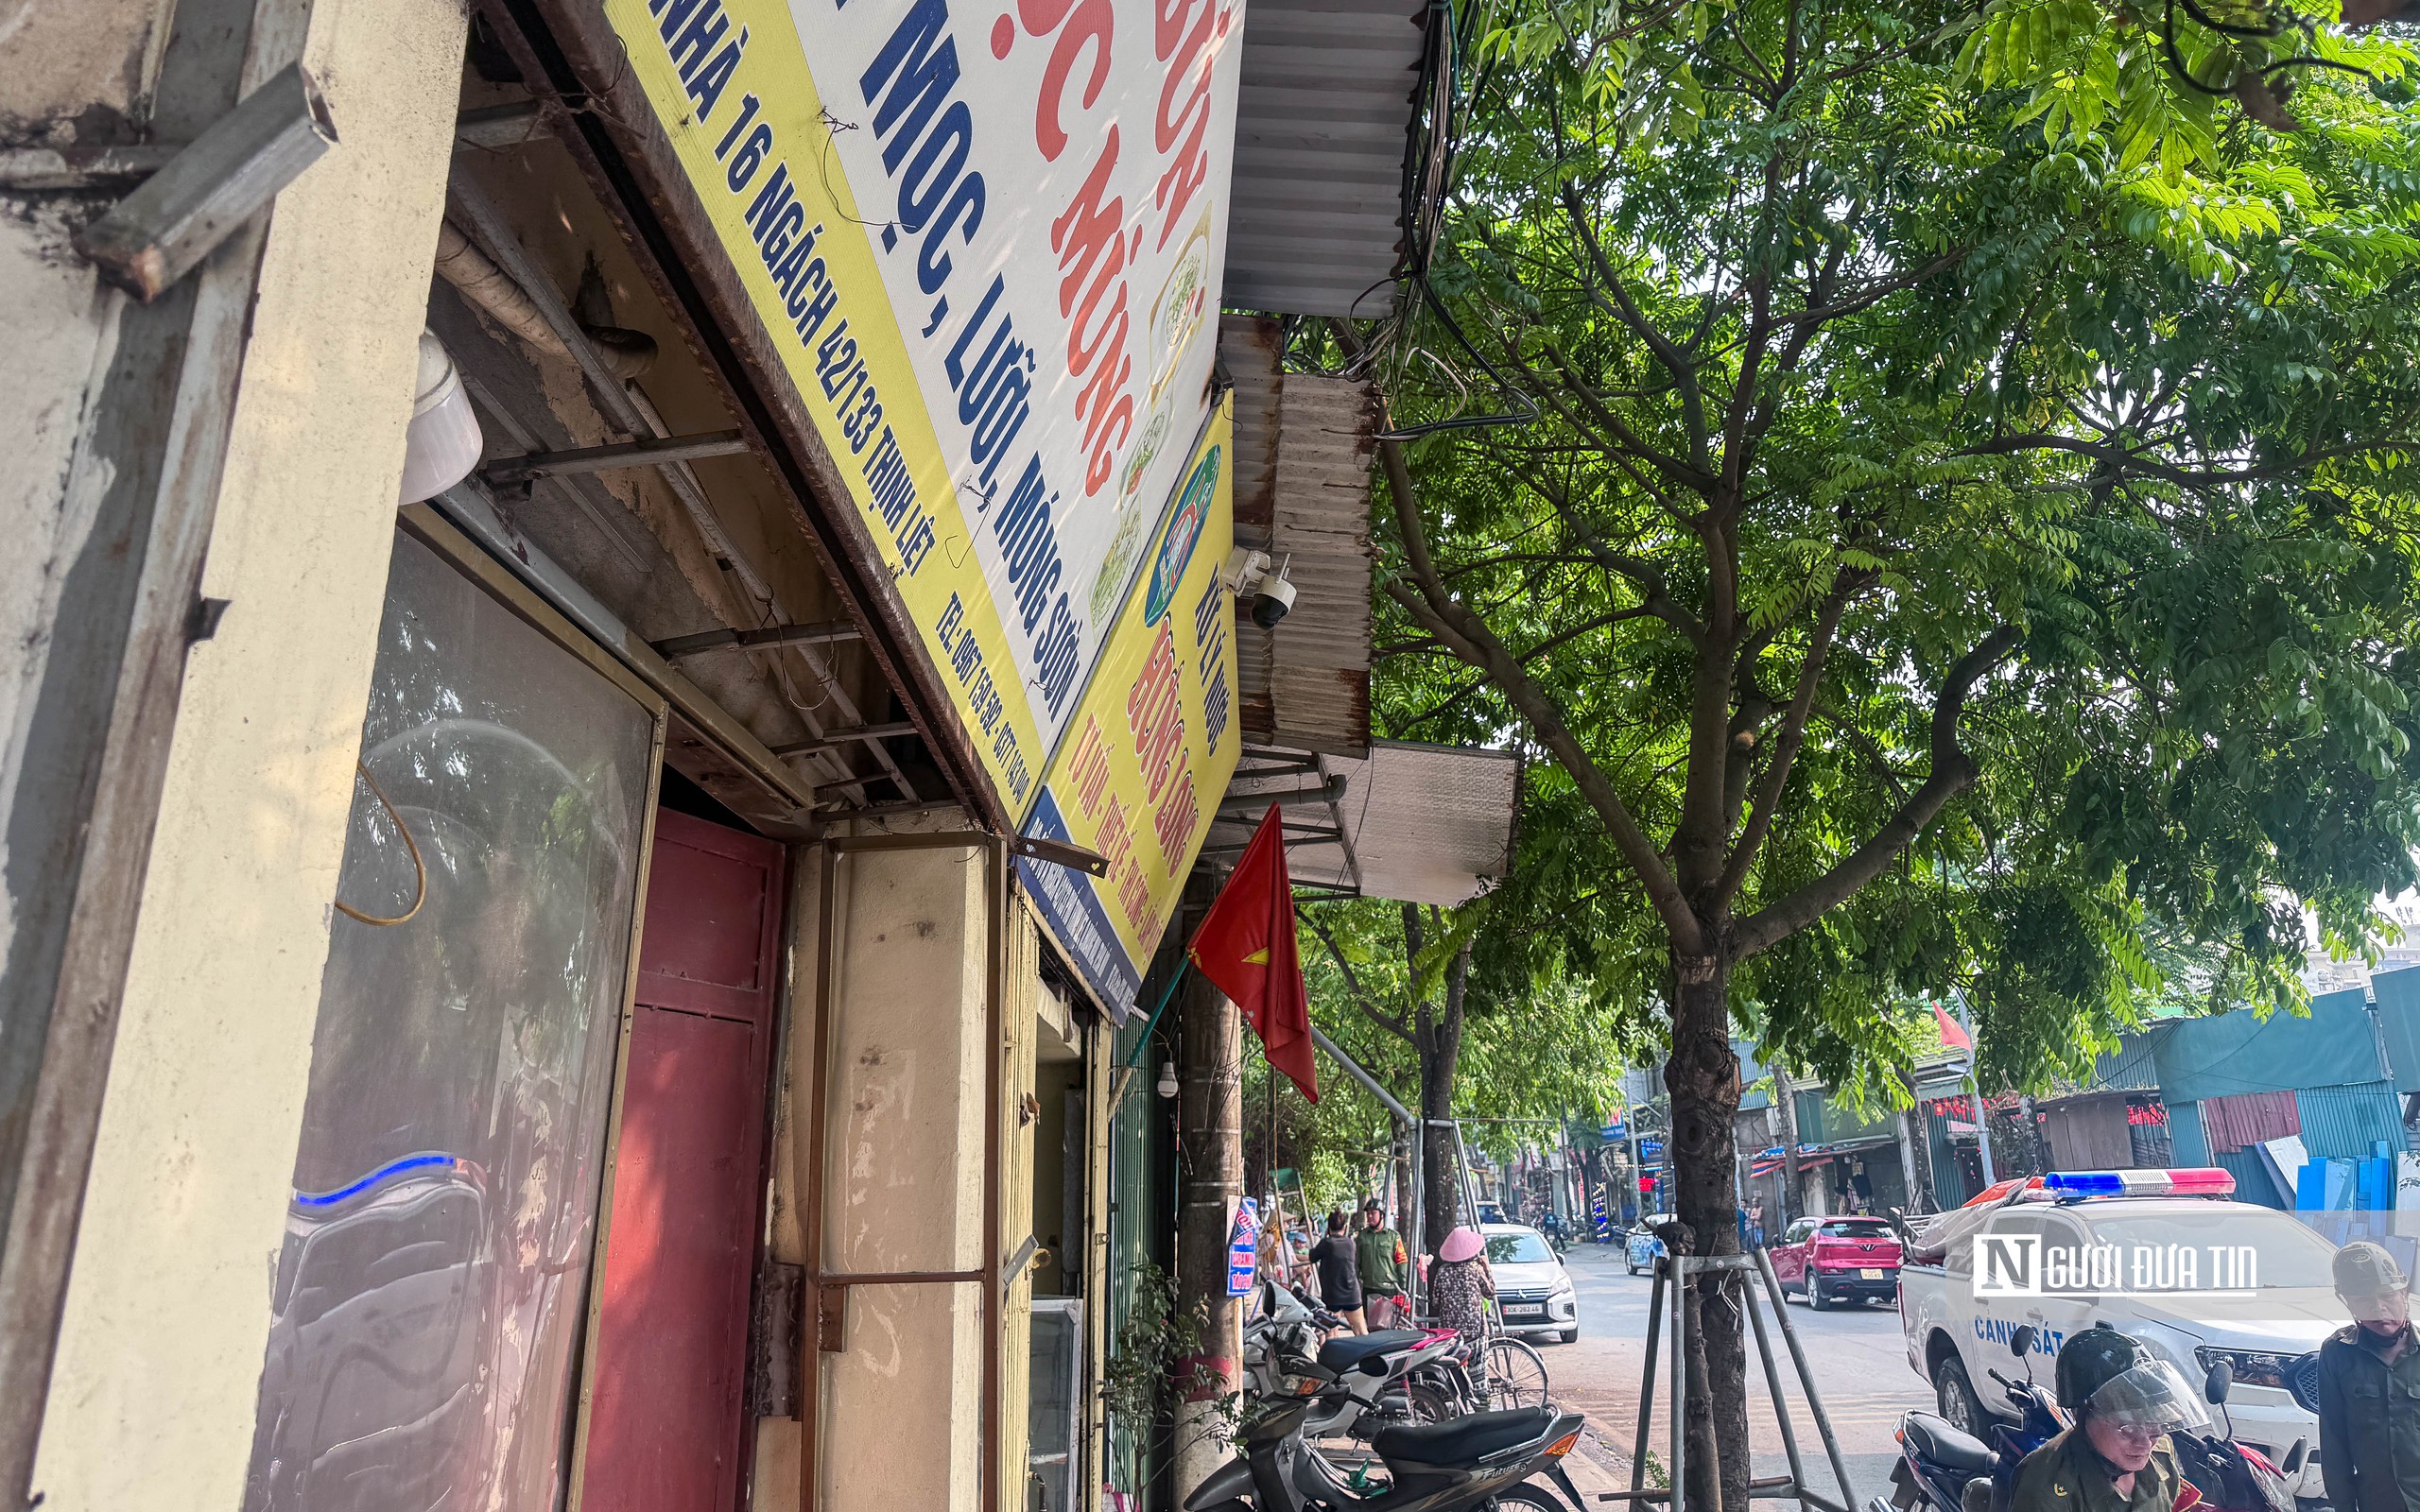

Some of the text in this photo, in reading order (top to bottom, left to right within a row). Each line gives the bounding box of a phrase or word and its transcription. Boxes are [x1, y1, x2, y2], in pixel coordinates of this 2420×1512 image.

[648, 0, 936, 578] NHÀ 16 NGÁCH 42/133 THỊNH LIỆT
[1050, 123, 1143, 497] MÙNG
[859, 0, 986, 338] MỌC,
[944, 272, 1037, 513] LƯỠI,
[994, 450, 1063, 639] MÓNG
[1032, 591, 1084, 724] SƯỜN
[936, 590, 964, 655] TEL:
[951, 627, 983, 689] 0967
[1200, 618, 1227, 688] LÝ
[968, 665, 994, 715] 159
[979, 690, 1003, 738] 592
[1203, 660, 1231, 758] NƯỚC
[994, 720, 1017, 769] 0377
[1067, 711, 1103, 785] TƯ
[1127, 610, 1200, 880] HƯNG LONG
[1077, 741, 1115, 822] VẤN
[2031, 1321, 2064, 1358] SÁT
